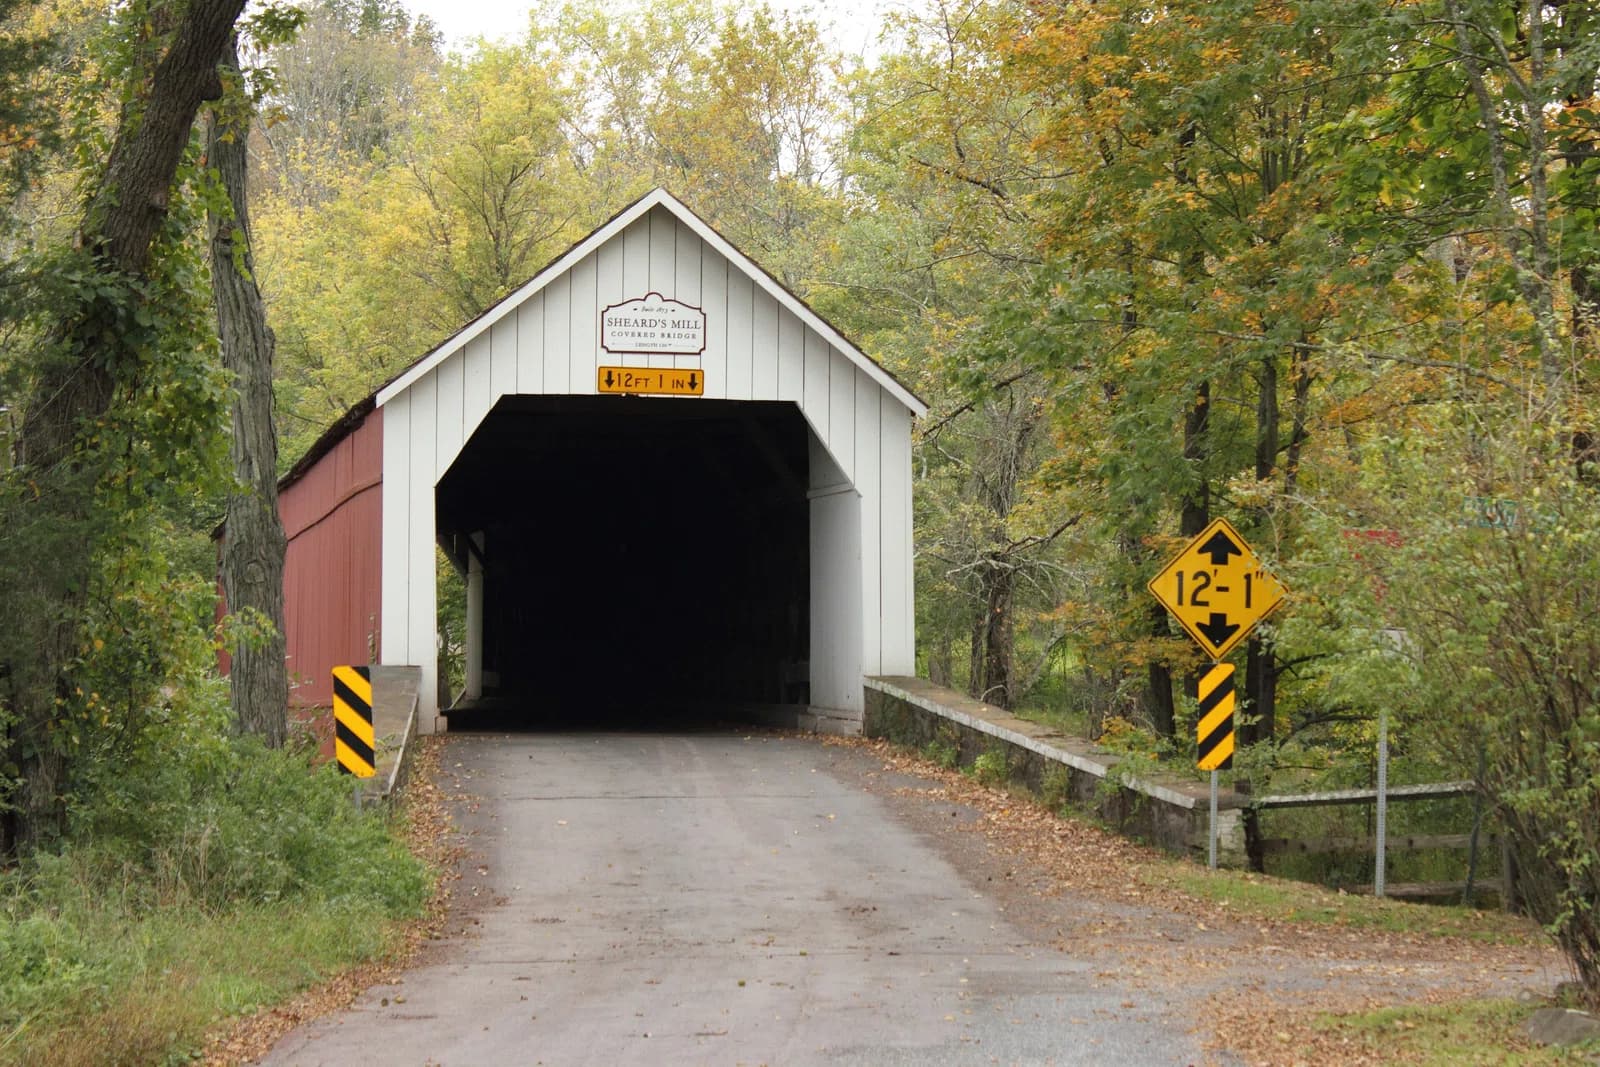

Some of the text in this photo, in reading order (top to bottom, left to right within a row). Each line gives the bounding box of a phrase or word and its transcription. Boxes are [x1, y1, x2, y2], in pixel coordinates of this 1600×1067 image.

[607, 317, 702, 330] SHEARD'S MILL
[660, 332, 697, 340] BRIDGE
[659, 373, 663, 389] 1
[671, 379, 685, 389] IN
